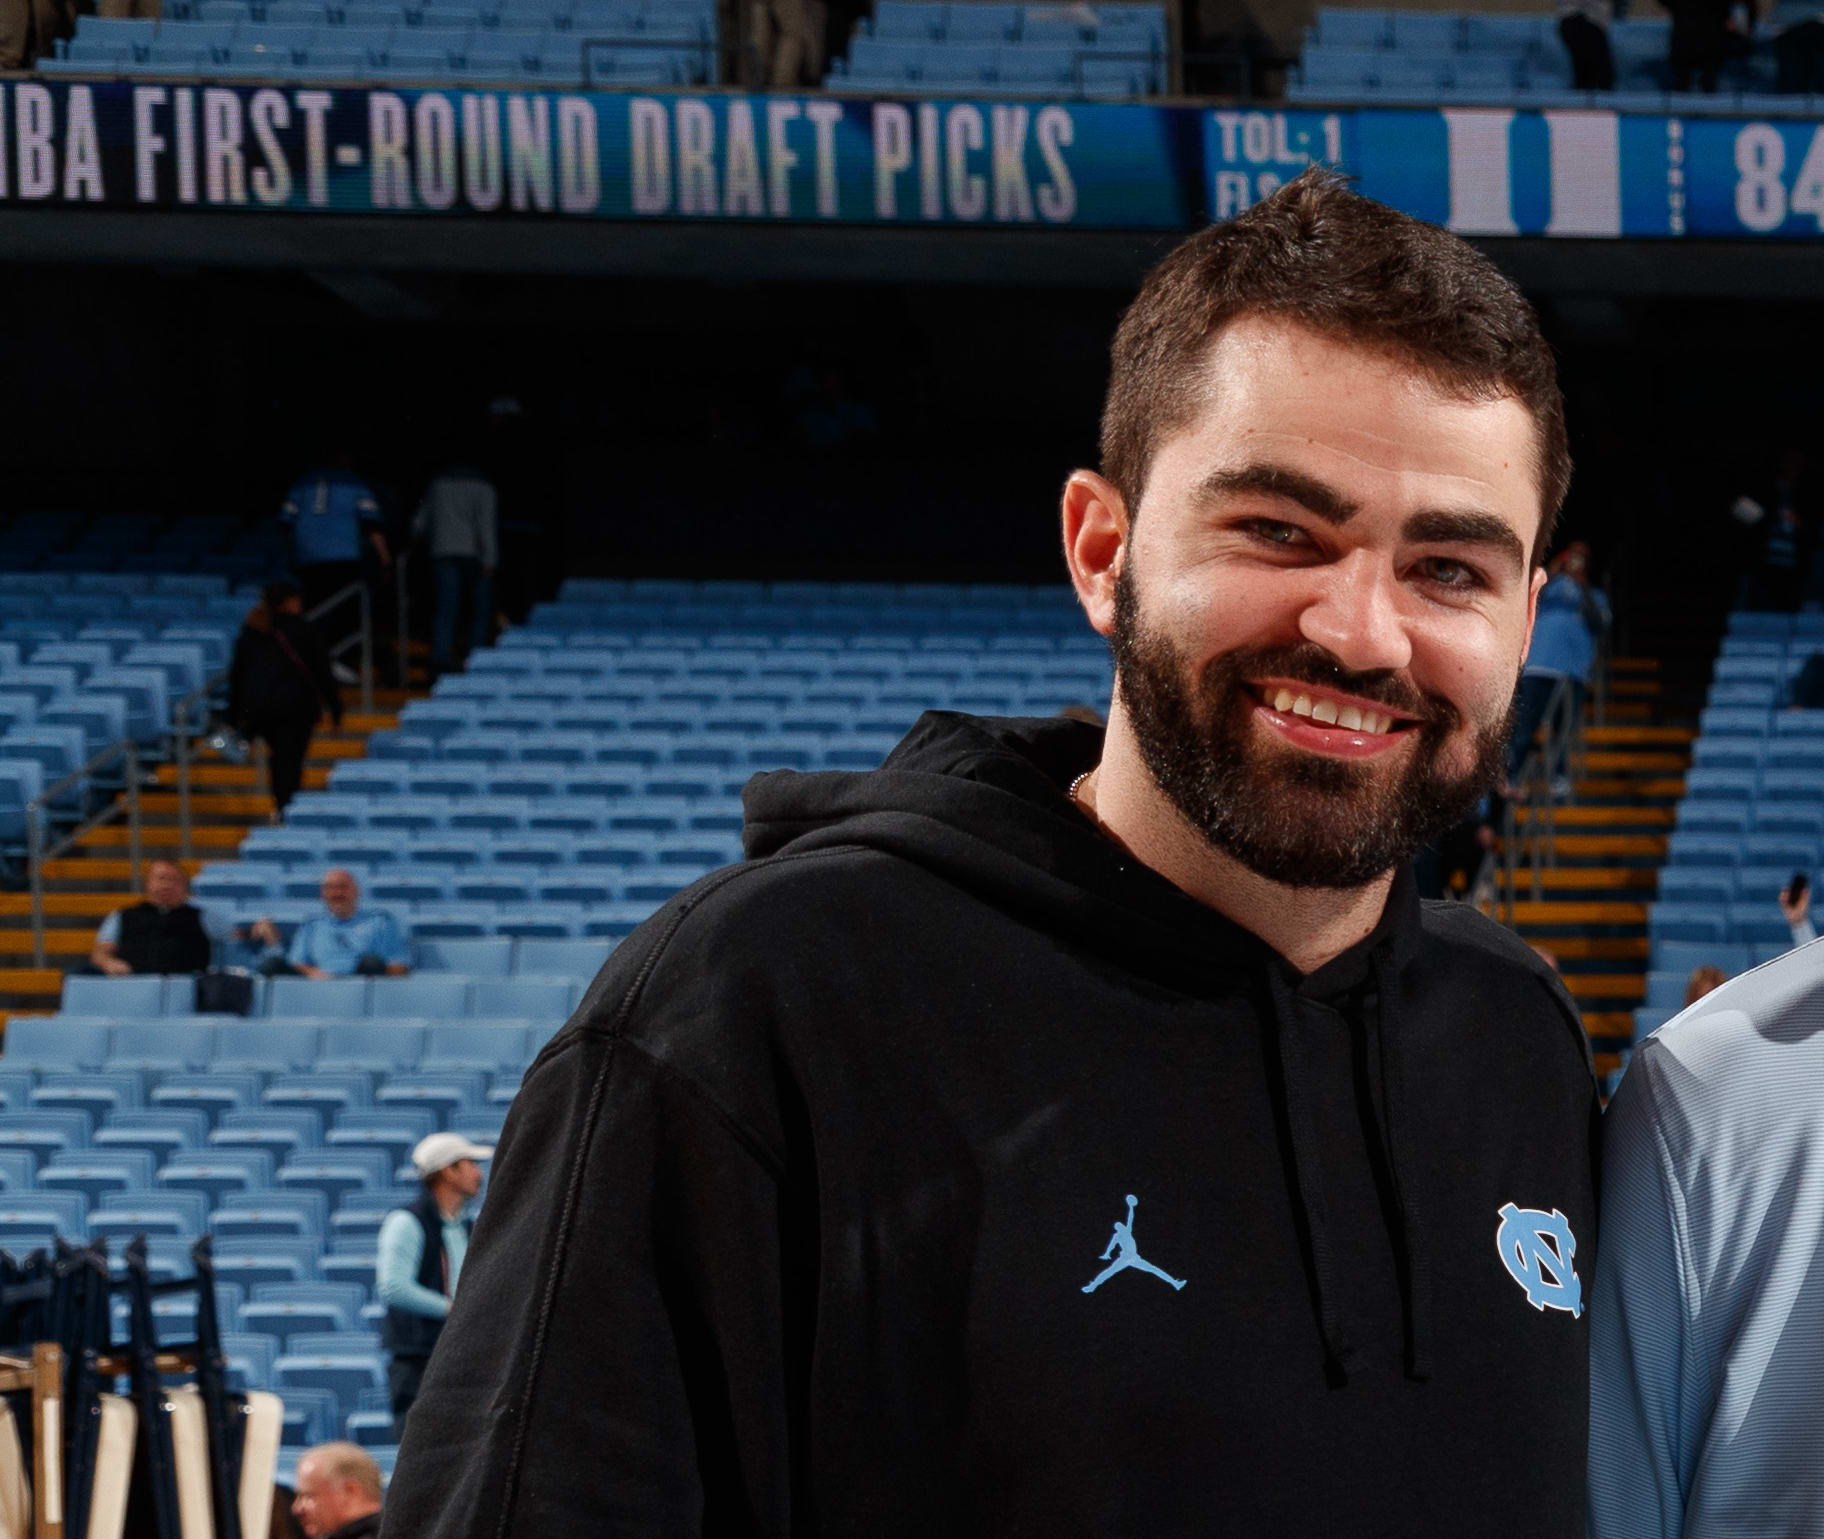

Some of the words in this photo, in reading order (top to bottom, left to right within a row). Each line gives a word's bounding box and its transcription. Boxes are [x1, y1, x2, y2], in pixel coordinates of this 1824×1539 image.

[0, 83, 104, 201] BA
[133, 87, 599, 214] FIRST-ROUND
[629, 99, 842, 217] DRAFT
[874, 102, 1077, 222] PICKS
[1215, 111, 1310, 164] TOL:
